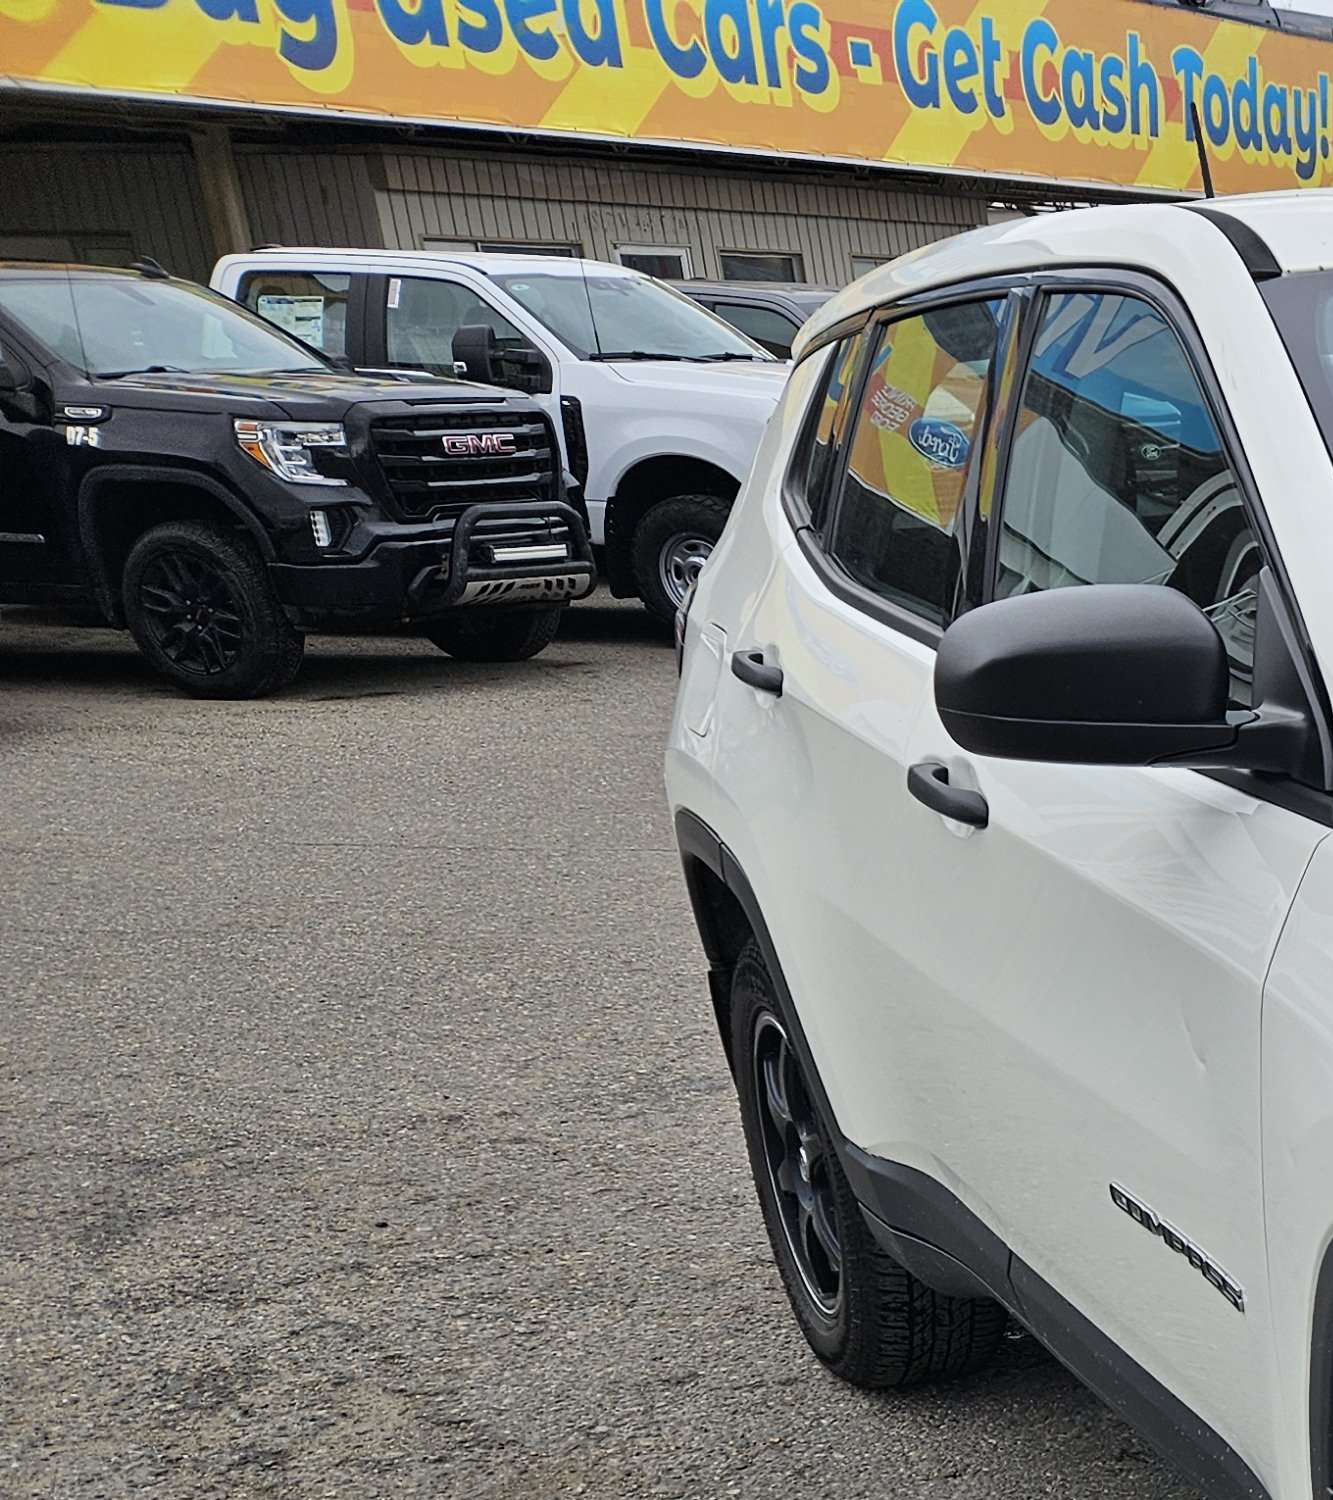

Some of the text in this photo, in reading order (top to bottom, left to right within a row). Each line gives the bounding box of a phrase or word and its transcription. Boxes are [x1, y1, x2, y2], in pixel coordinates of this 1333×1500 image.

[645, 0, 830, 95] Cars
[894, 0, 1006, 118] Get
[1021, 19, 1160, 139] Cash
[1172, 46, 1330, 181] Today!
[441, 433, 517, 455] GMC
